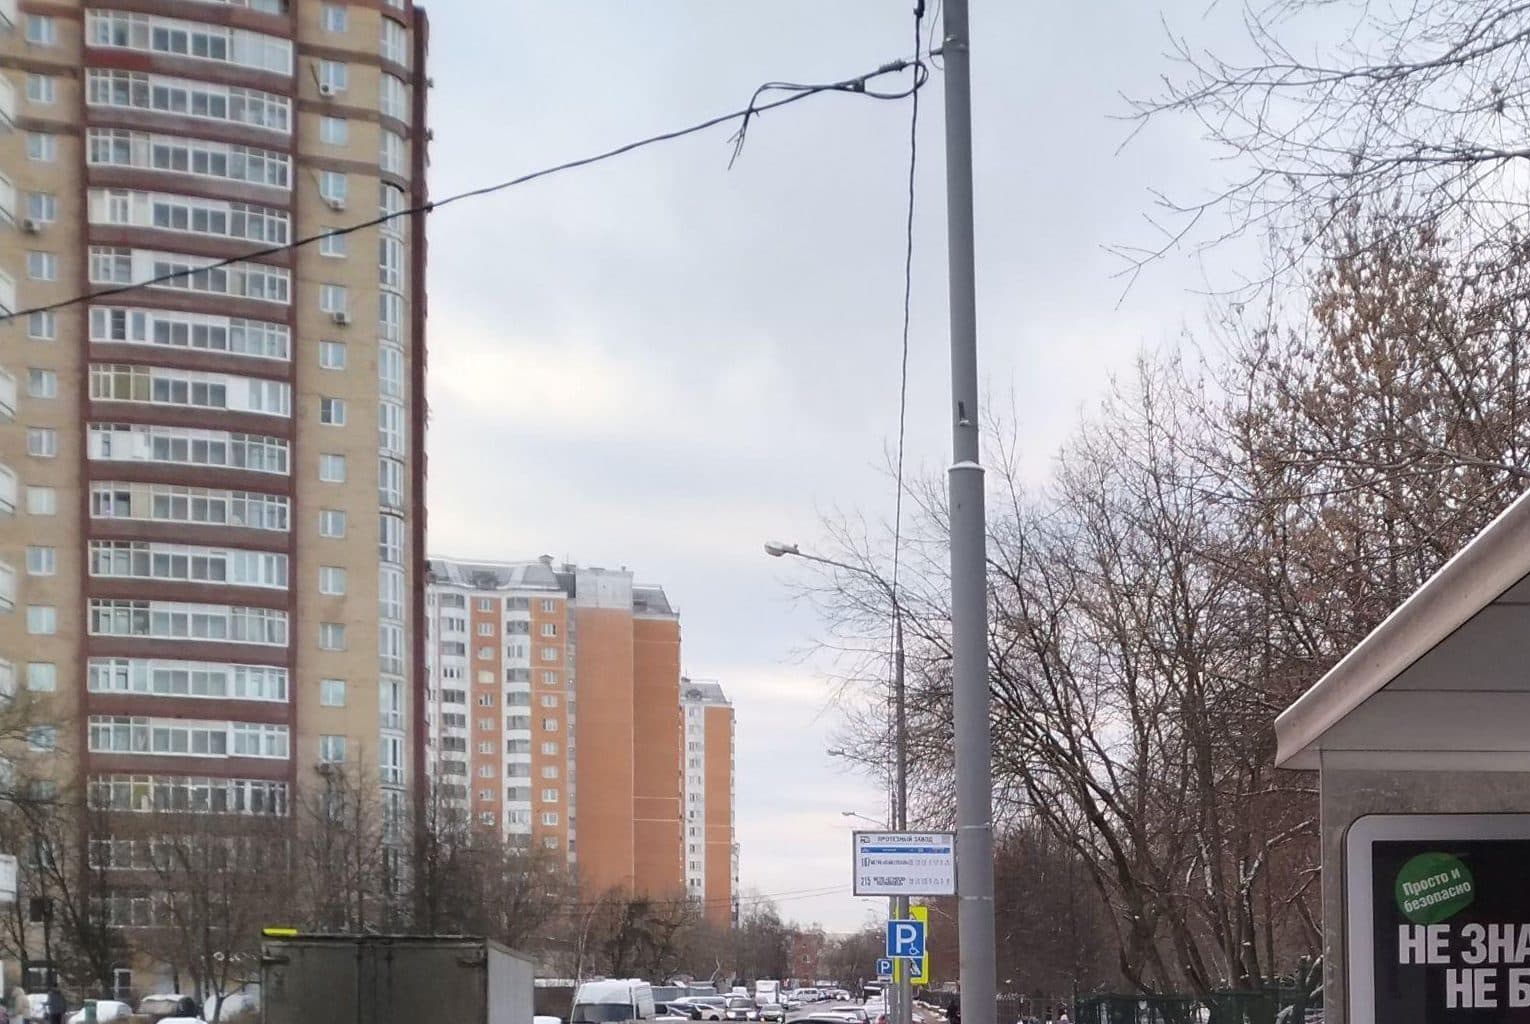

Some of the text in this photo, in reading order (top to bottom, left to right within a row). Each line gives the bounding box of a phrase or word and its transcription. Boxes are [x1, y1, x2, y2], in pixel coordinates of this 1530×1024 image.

[1402, 867, 1461, 897] Просто и
[1403, 881, 1472, 913] безопасно
[1399, 924, 1450, 964] НЕ
[1446, 968, 1498, 1008] НЕ
